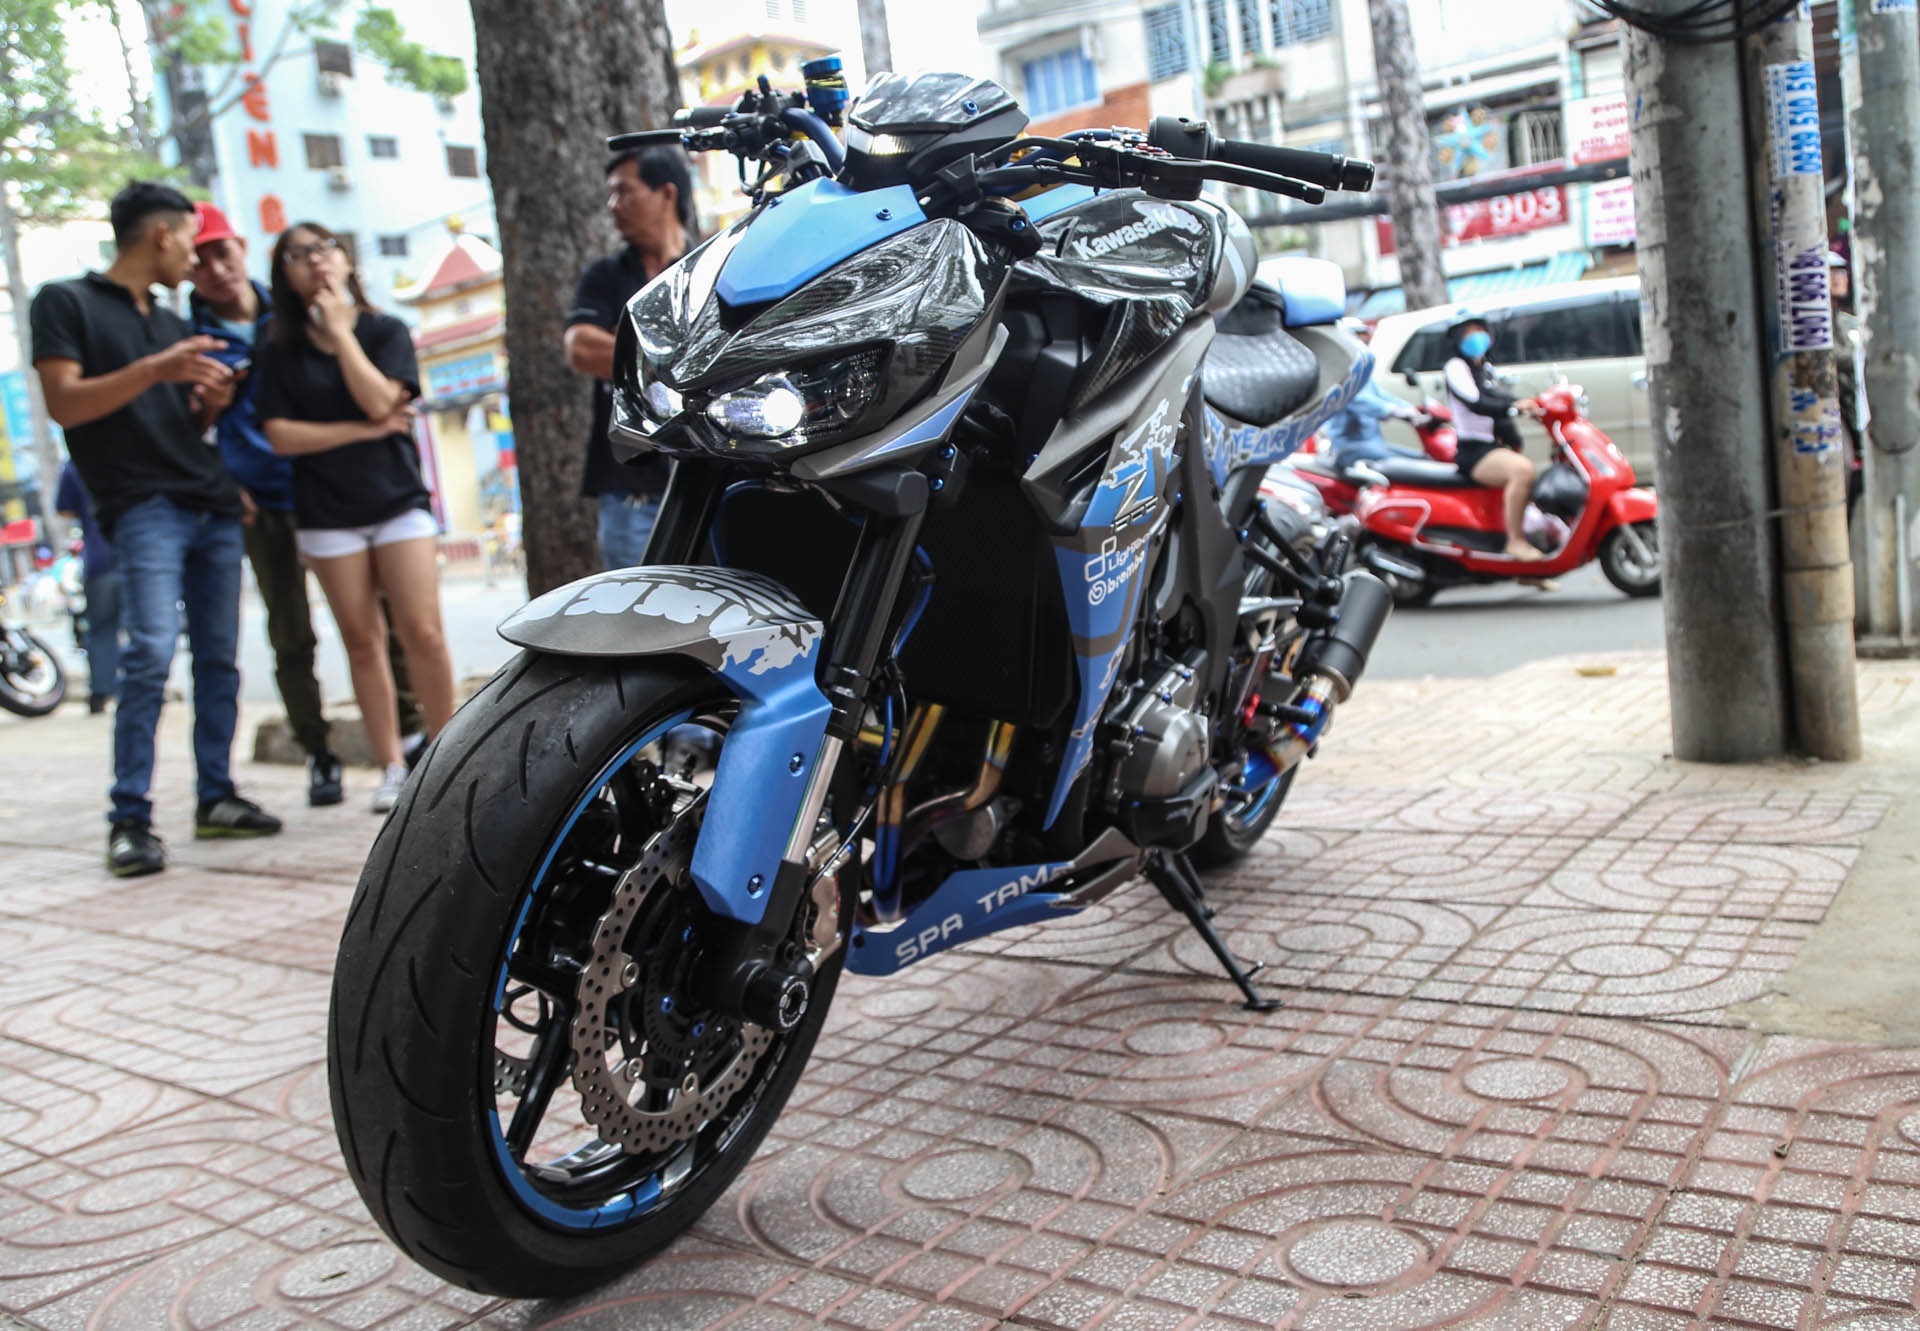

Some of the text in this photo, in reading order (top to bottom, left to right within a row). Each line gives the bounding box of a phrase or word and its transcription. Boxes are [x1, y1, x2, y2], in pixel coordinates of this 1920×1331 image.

[1489, 185, 1562, 228] 903
[1072, 204, 1179, 260] Kawasaki
[1230, 425, 1291, 457] YEAR
[1107, 550, 1145, 595] brembo
[895, 913, 963, 966] SPA
